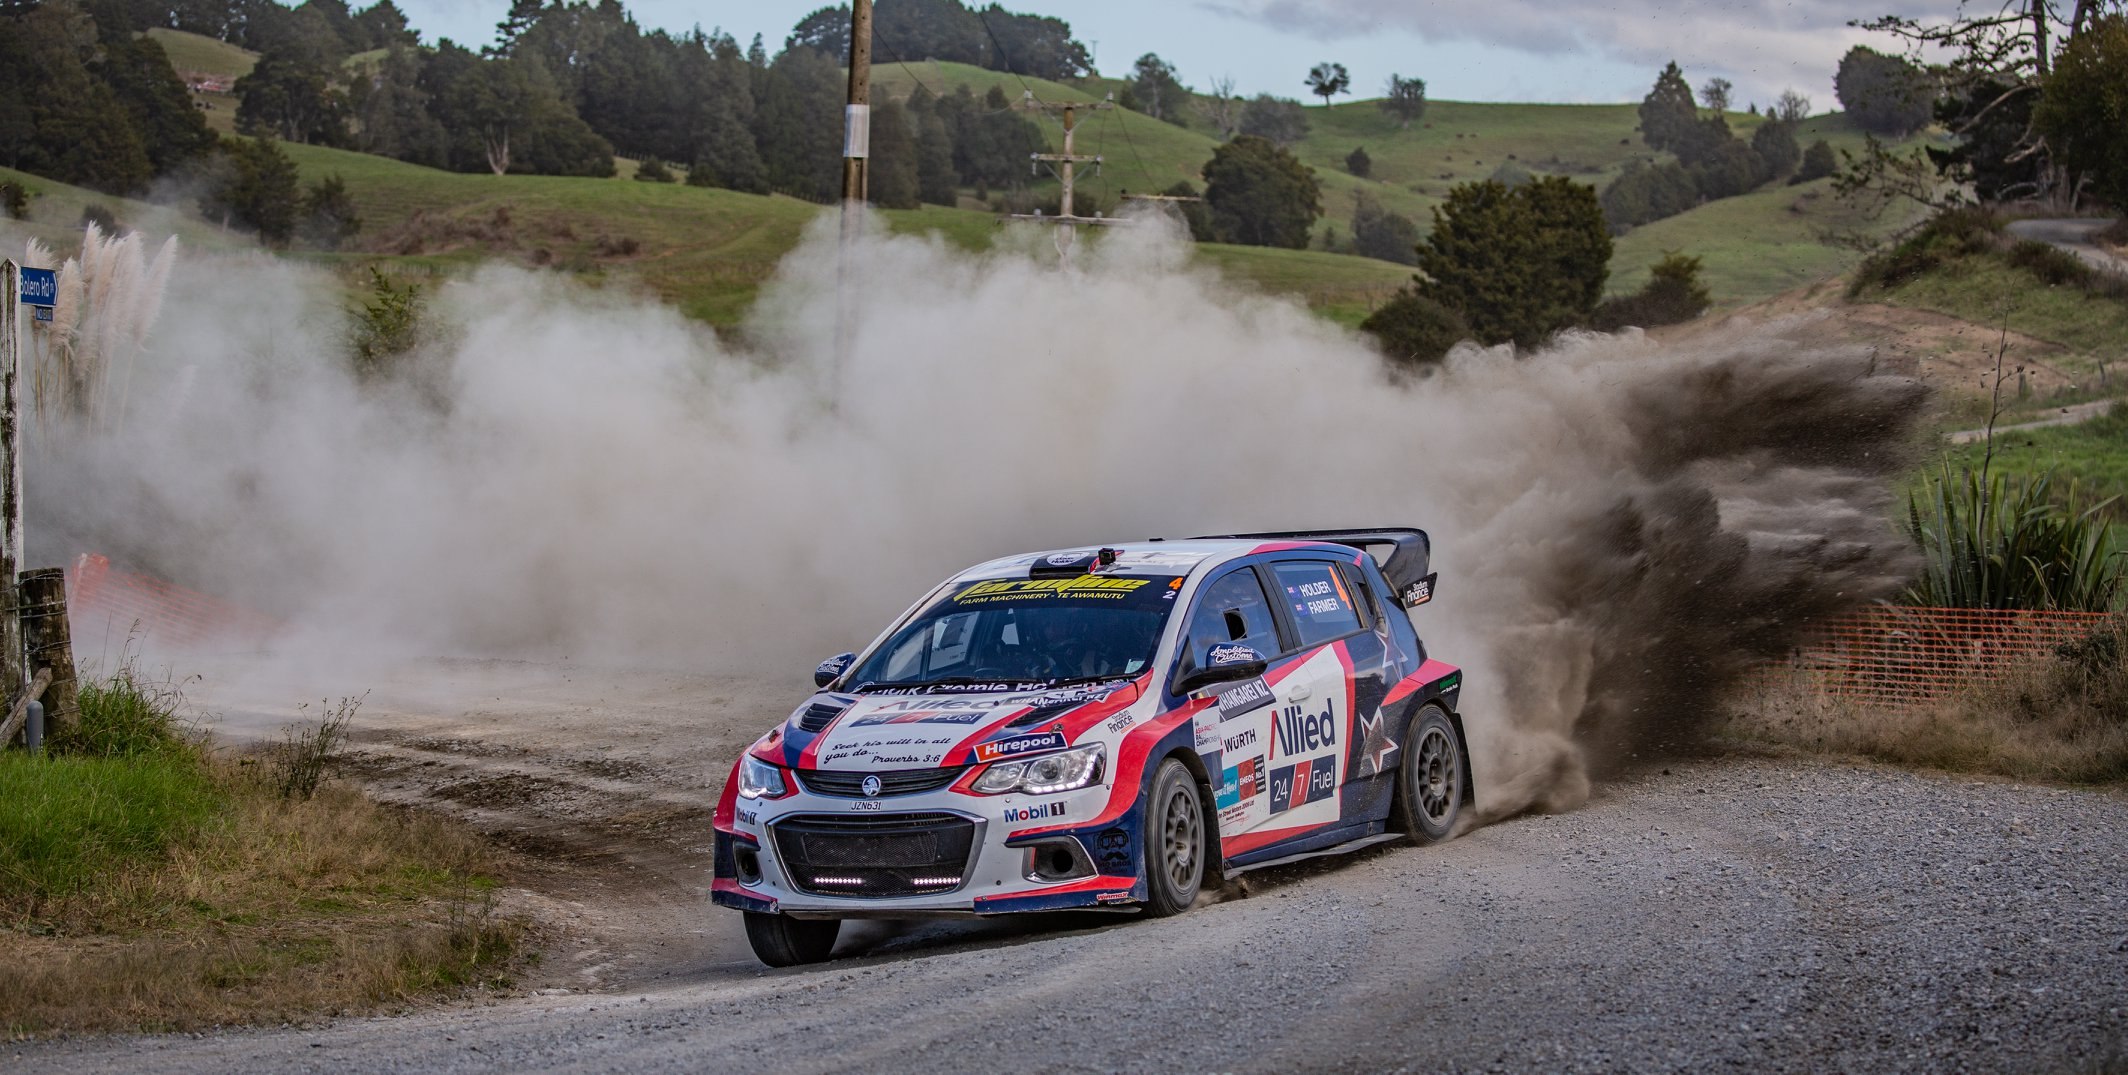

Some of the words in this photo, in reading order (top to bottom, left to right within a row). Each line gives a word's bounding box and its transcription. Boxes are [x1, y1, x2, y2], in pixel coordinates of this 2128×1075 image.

[20, 274, 40, 298] Bolero
[41, 276, 50, 298] Rd
[1168, 577, 1184, 590] 4
[1299, 581, 1332, 597] HOLDER
[1328, 566, 1352, 610] 4
[960, 596, 987, 606] FARM
[989, 593, 1050, 602] MACHINERY
[1070, 592, 1125, 600] AWAMUTU
[1162, 590, 1176, 600] 2
[1407, 587, 1429, 602] Finance
[1307, 597, 1340, 615] FARMER
[1219, 682, 1260, 712] WHANGAREI
[1252, 679, 1270, 698] NZ
[871, 699, 1001, 712] Allied
[933, 713, 979, 721] Fuel
[1107, 715, 1133, 734] Finance
[1269, 697, 1335, 760] Allied
[832, 742, 859, 751] Seek
[886, 738, 911, 746] will
[985, 735, 1056, 756] Hirepool
[824, 752, 849, 764] you
[853, 748, 878, 757] do...
[872, 755, 919, 764] Proverbs
[923, 754, 940, 763] 3:6
[1239, 773, 1255, 786] ENEOS
[1274, 778, 1289, 803] 24
[1298, 773, 1305, 796] 7
[1312, 765, 1334, 792] Fuel
[851, 801, 881, 811] JZN631
[1004, 803, 1049, 823] Mobil
